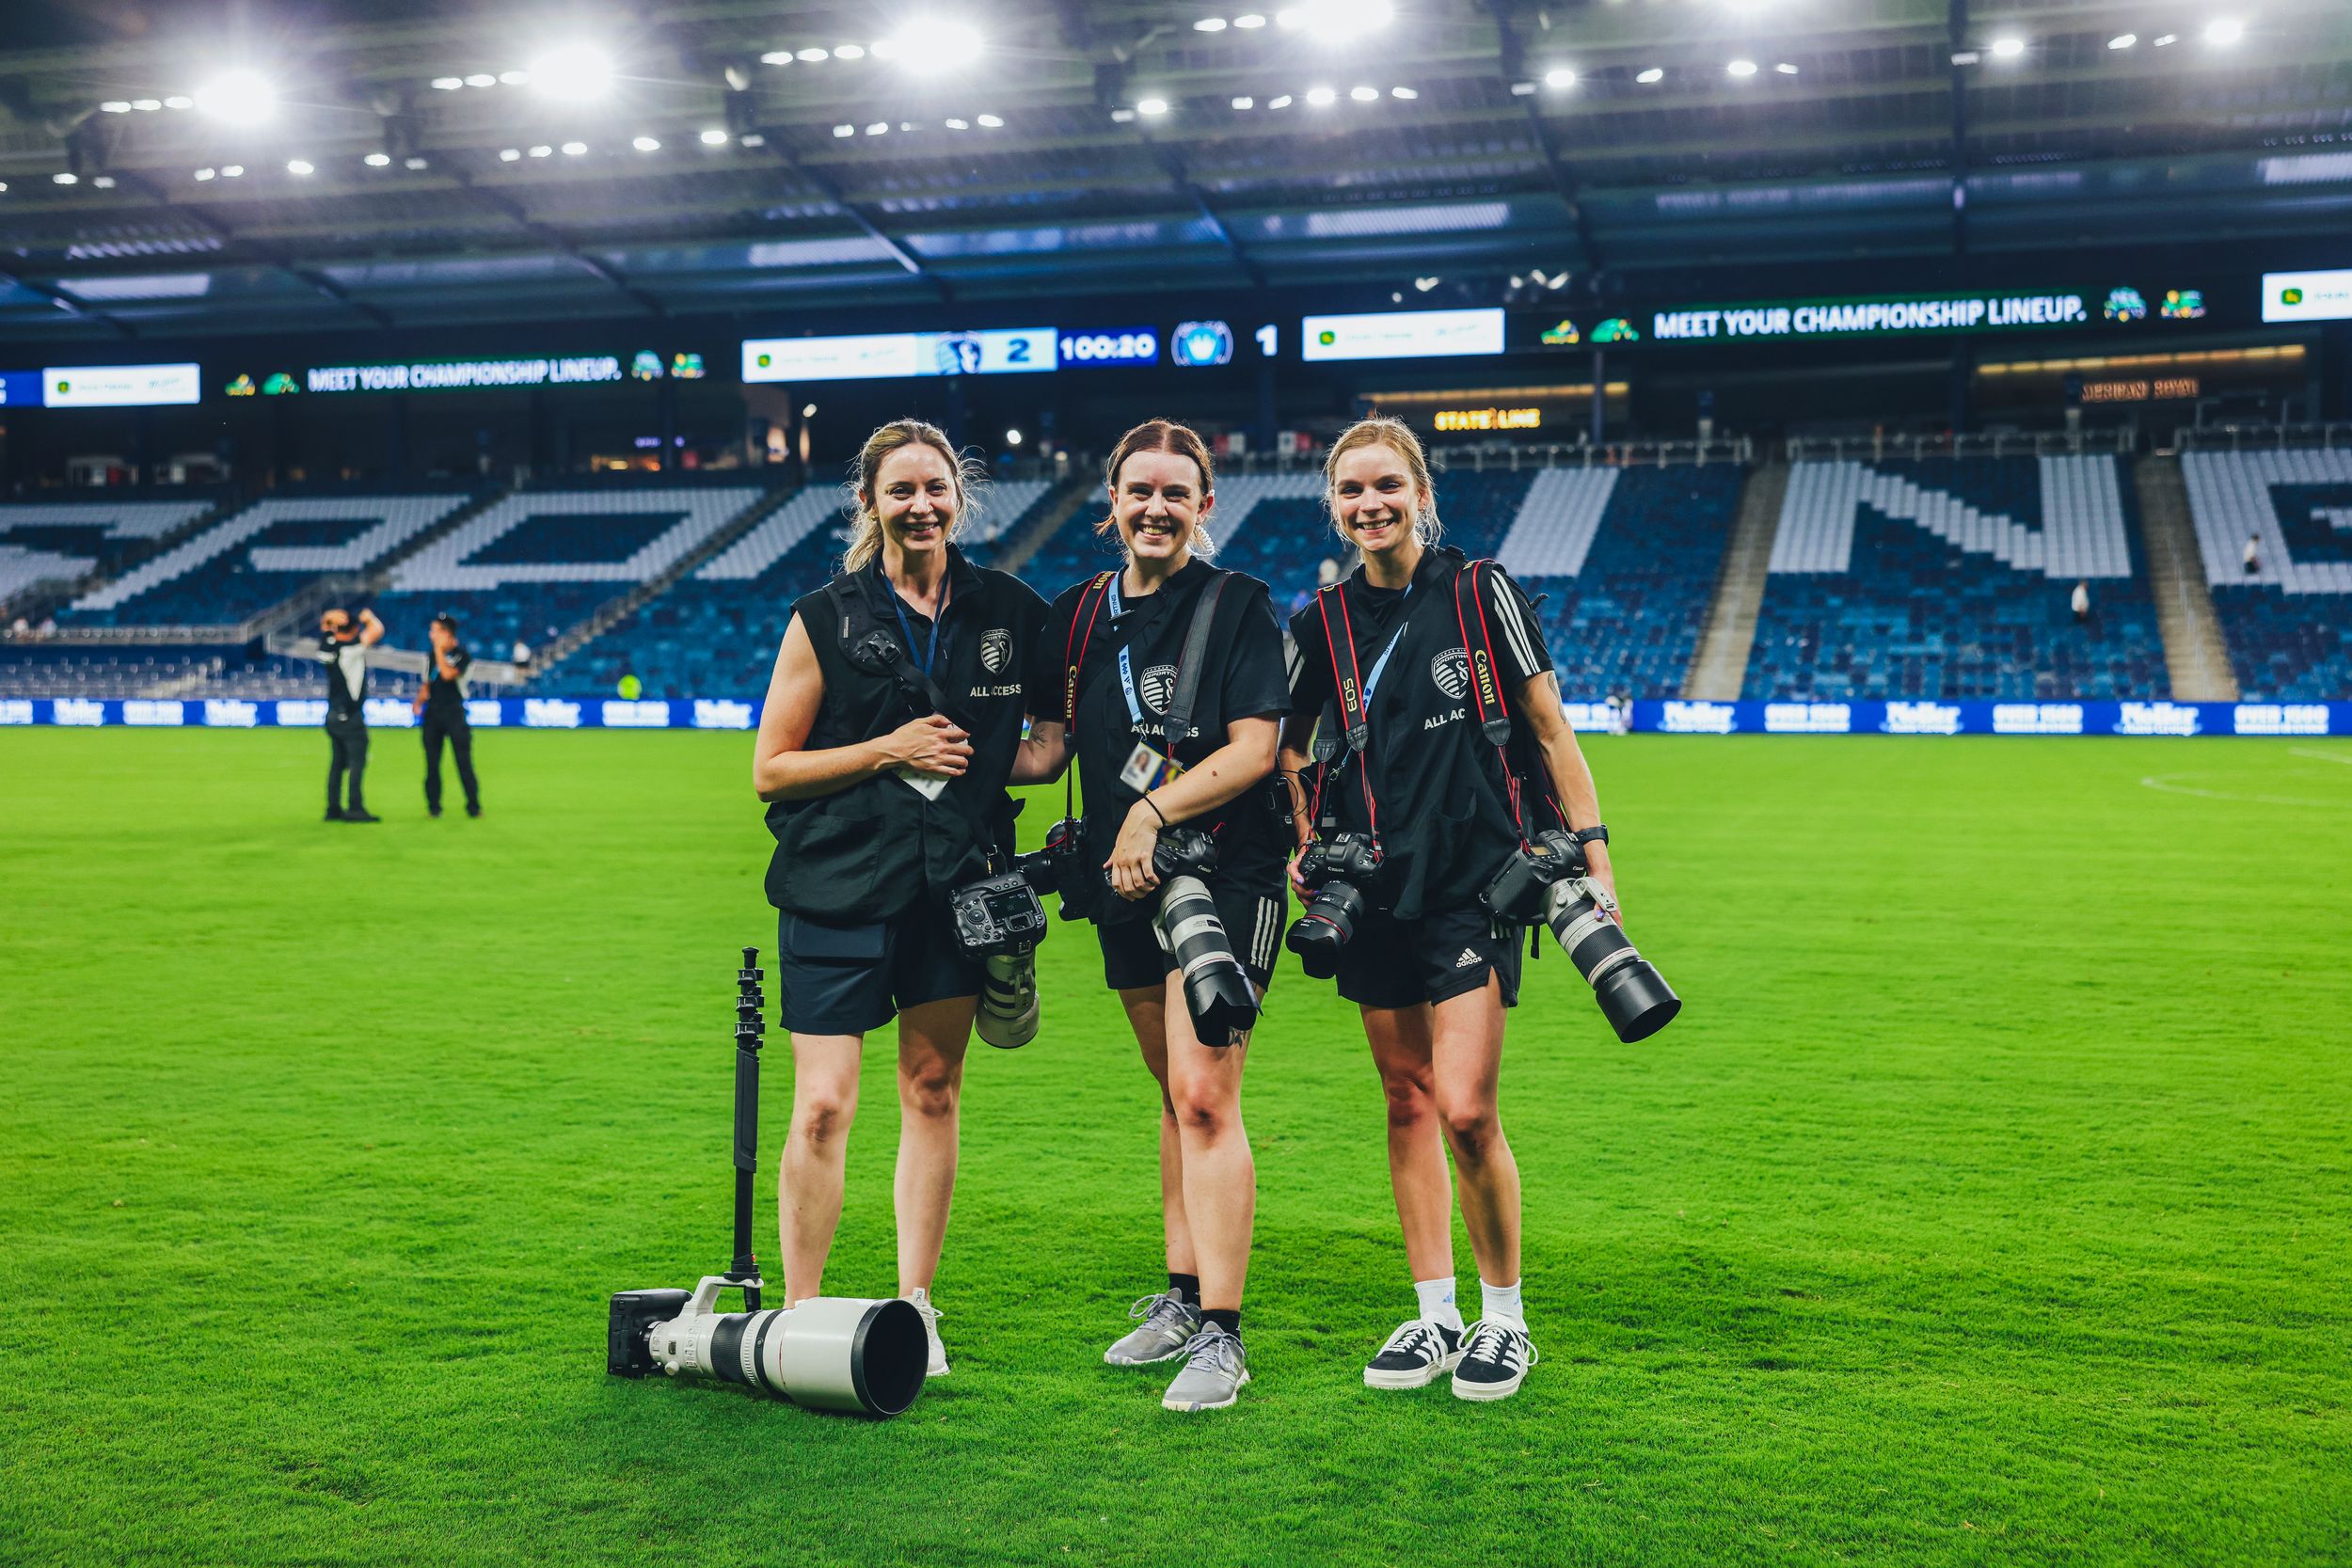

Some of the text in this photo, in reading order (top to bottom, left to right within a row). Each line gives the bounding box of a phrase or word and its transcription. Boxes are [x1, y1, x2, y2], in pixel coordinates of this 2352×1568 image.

[1653, 294, 2087, 340] MEET YOUR CHAMPIONSHIP LINEUP.
[1008, 338, 1030, 363] 2
[1059, 333, 1157, 361] 100:20
[1255, 325, 1279, 356] 1
[308, 356, 622, 392] MEET YOUR CHAMPIONSHIP LINEUP.
[1435, 407, 1541, 431] STATE LINE
[1475, 649, 1496, 705] Canon
[970, 686, 990, 697] ALL
[1066, 665, 1078, 719] Canon
[1343, 677, 1358, 712] EOS
[1131, 723, 1150, 734] AL
[1423, 715, 1448, 730] ALL
[1456, 956, 1483, 968] adidas
